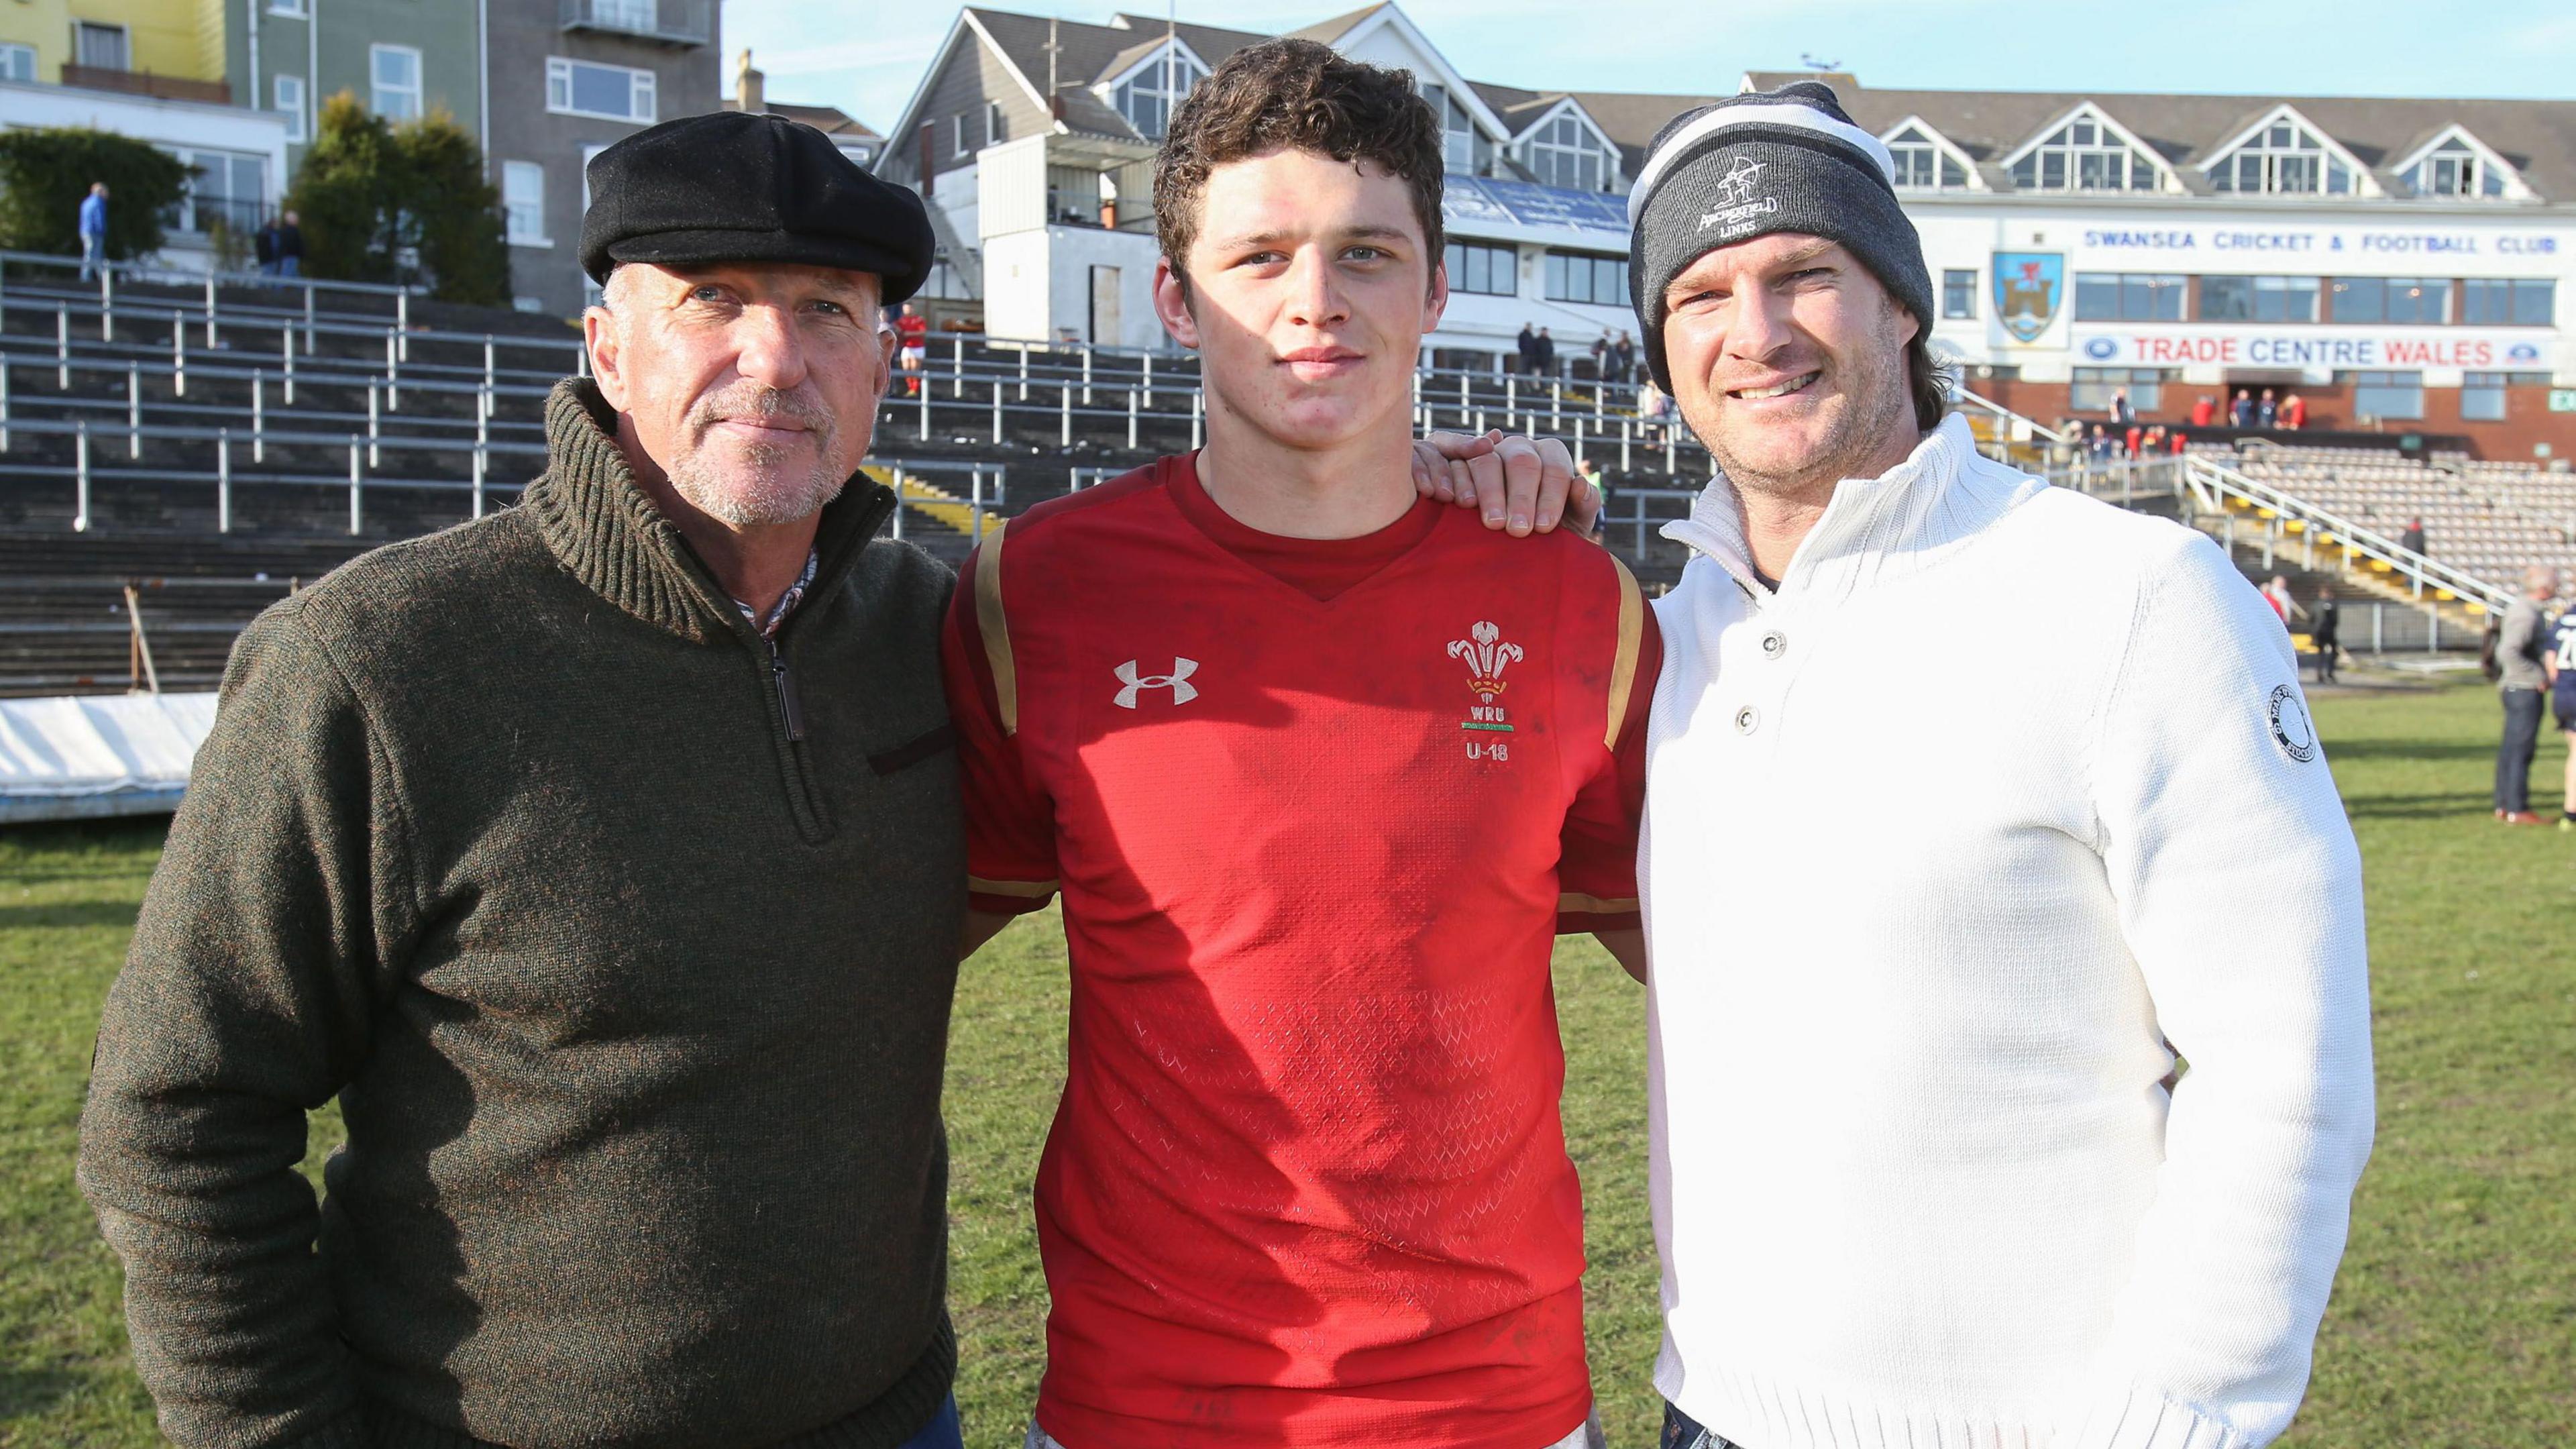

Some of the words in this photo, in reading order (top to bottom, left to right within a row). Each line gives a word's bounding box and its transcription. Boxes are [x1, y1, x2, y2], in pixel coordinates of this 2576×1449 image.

[1720, 221, 1756, 237] LINKS
[2085, 231, 2196, 248] SWANSEA
[2214, 232, 2314, 250] CRICKET
[2330, 235, 2342, 251] &
[2363, 235, 2478, 252] FOOTBALL
[2498, 237, 2557, 254] CLUB
[2135, 338, 2238, 361] TRADE
[2250, 339, 2373, 363] CENTRE
[2385, 340, 2491, 365] WALES
[1470, 706, 1504, 722] WRU
[1466, 742, 1508, 761] U-18
